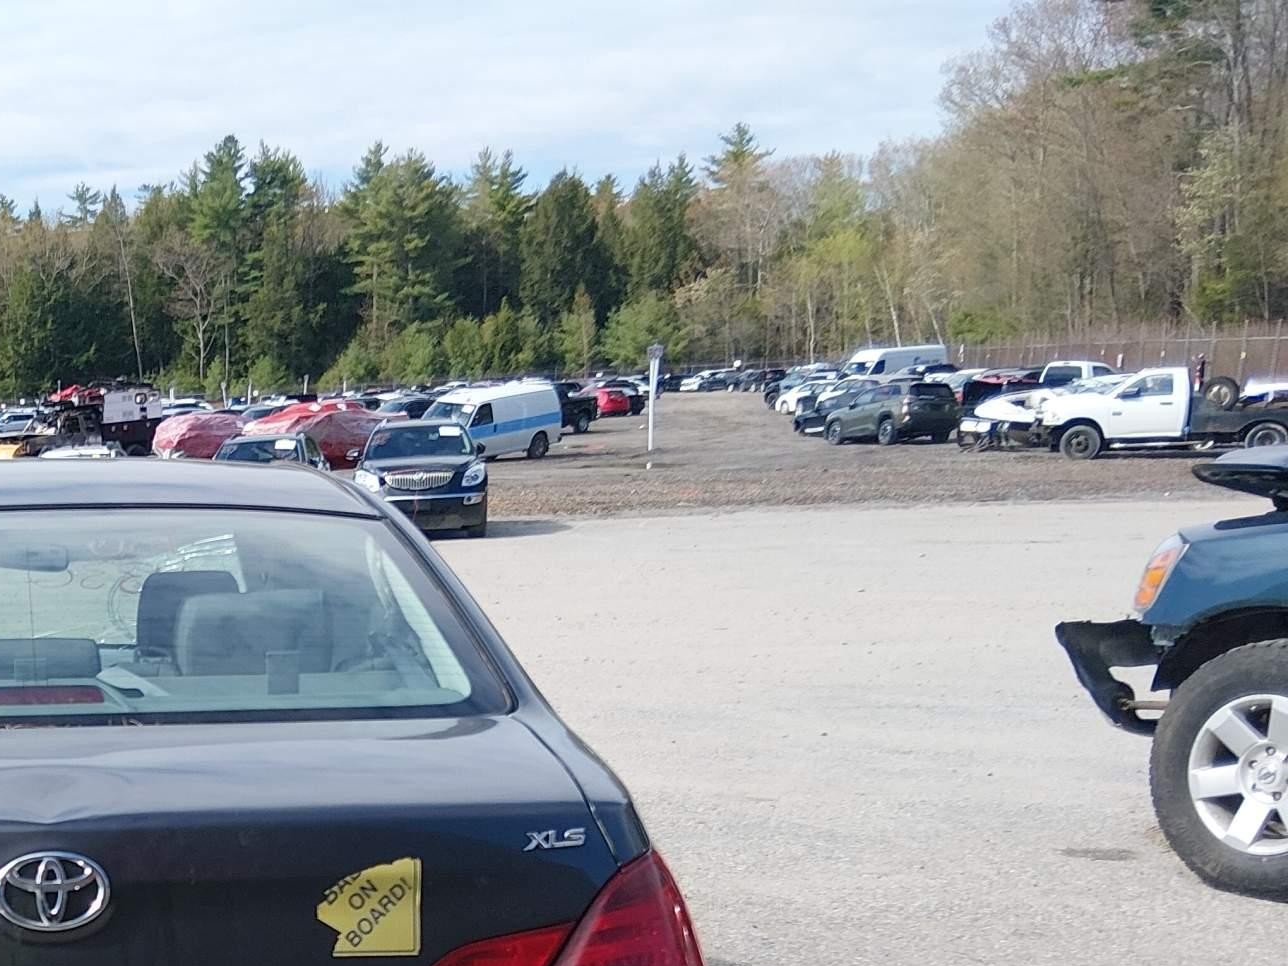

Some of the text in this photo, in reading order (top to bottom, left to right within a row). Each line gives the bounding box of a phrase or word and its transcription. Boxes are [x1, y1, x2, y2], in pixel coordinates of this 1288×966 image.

[523, 827, 586, 852] XLS
[348, 879, 379, 910] ON
[345, 877, 412, 948] BOARD!
